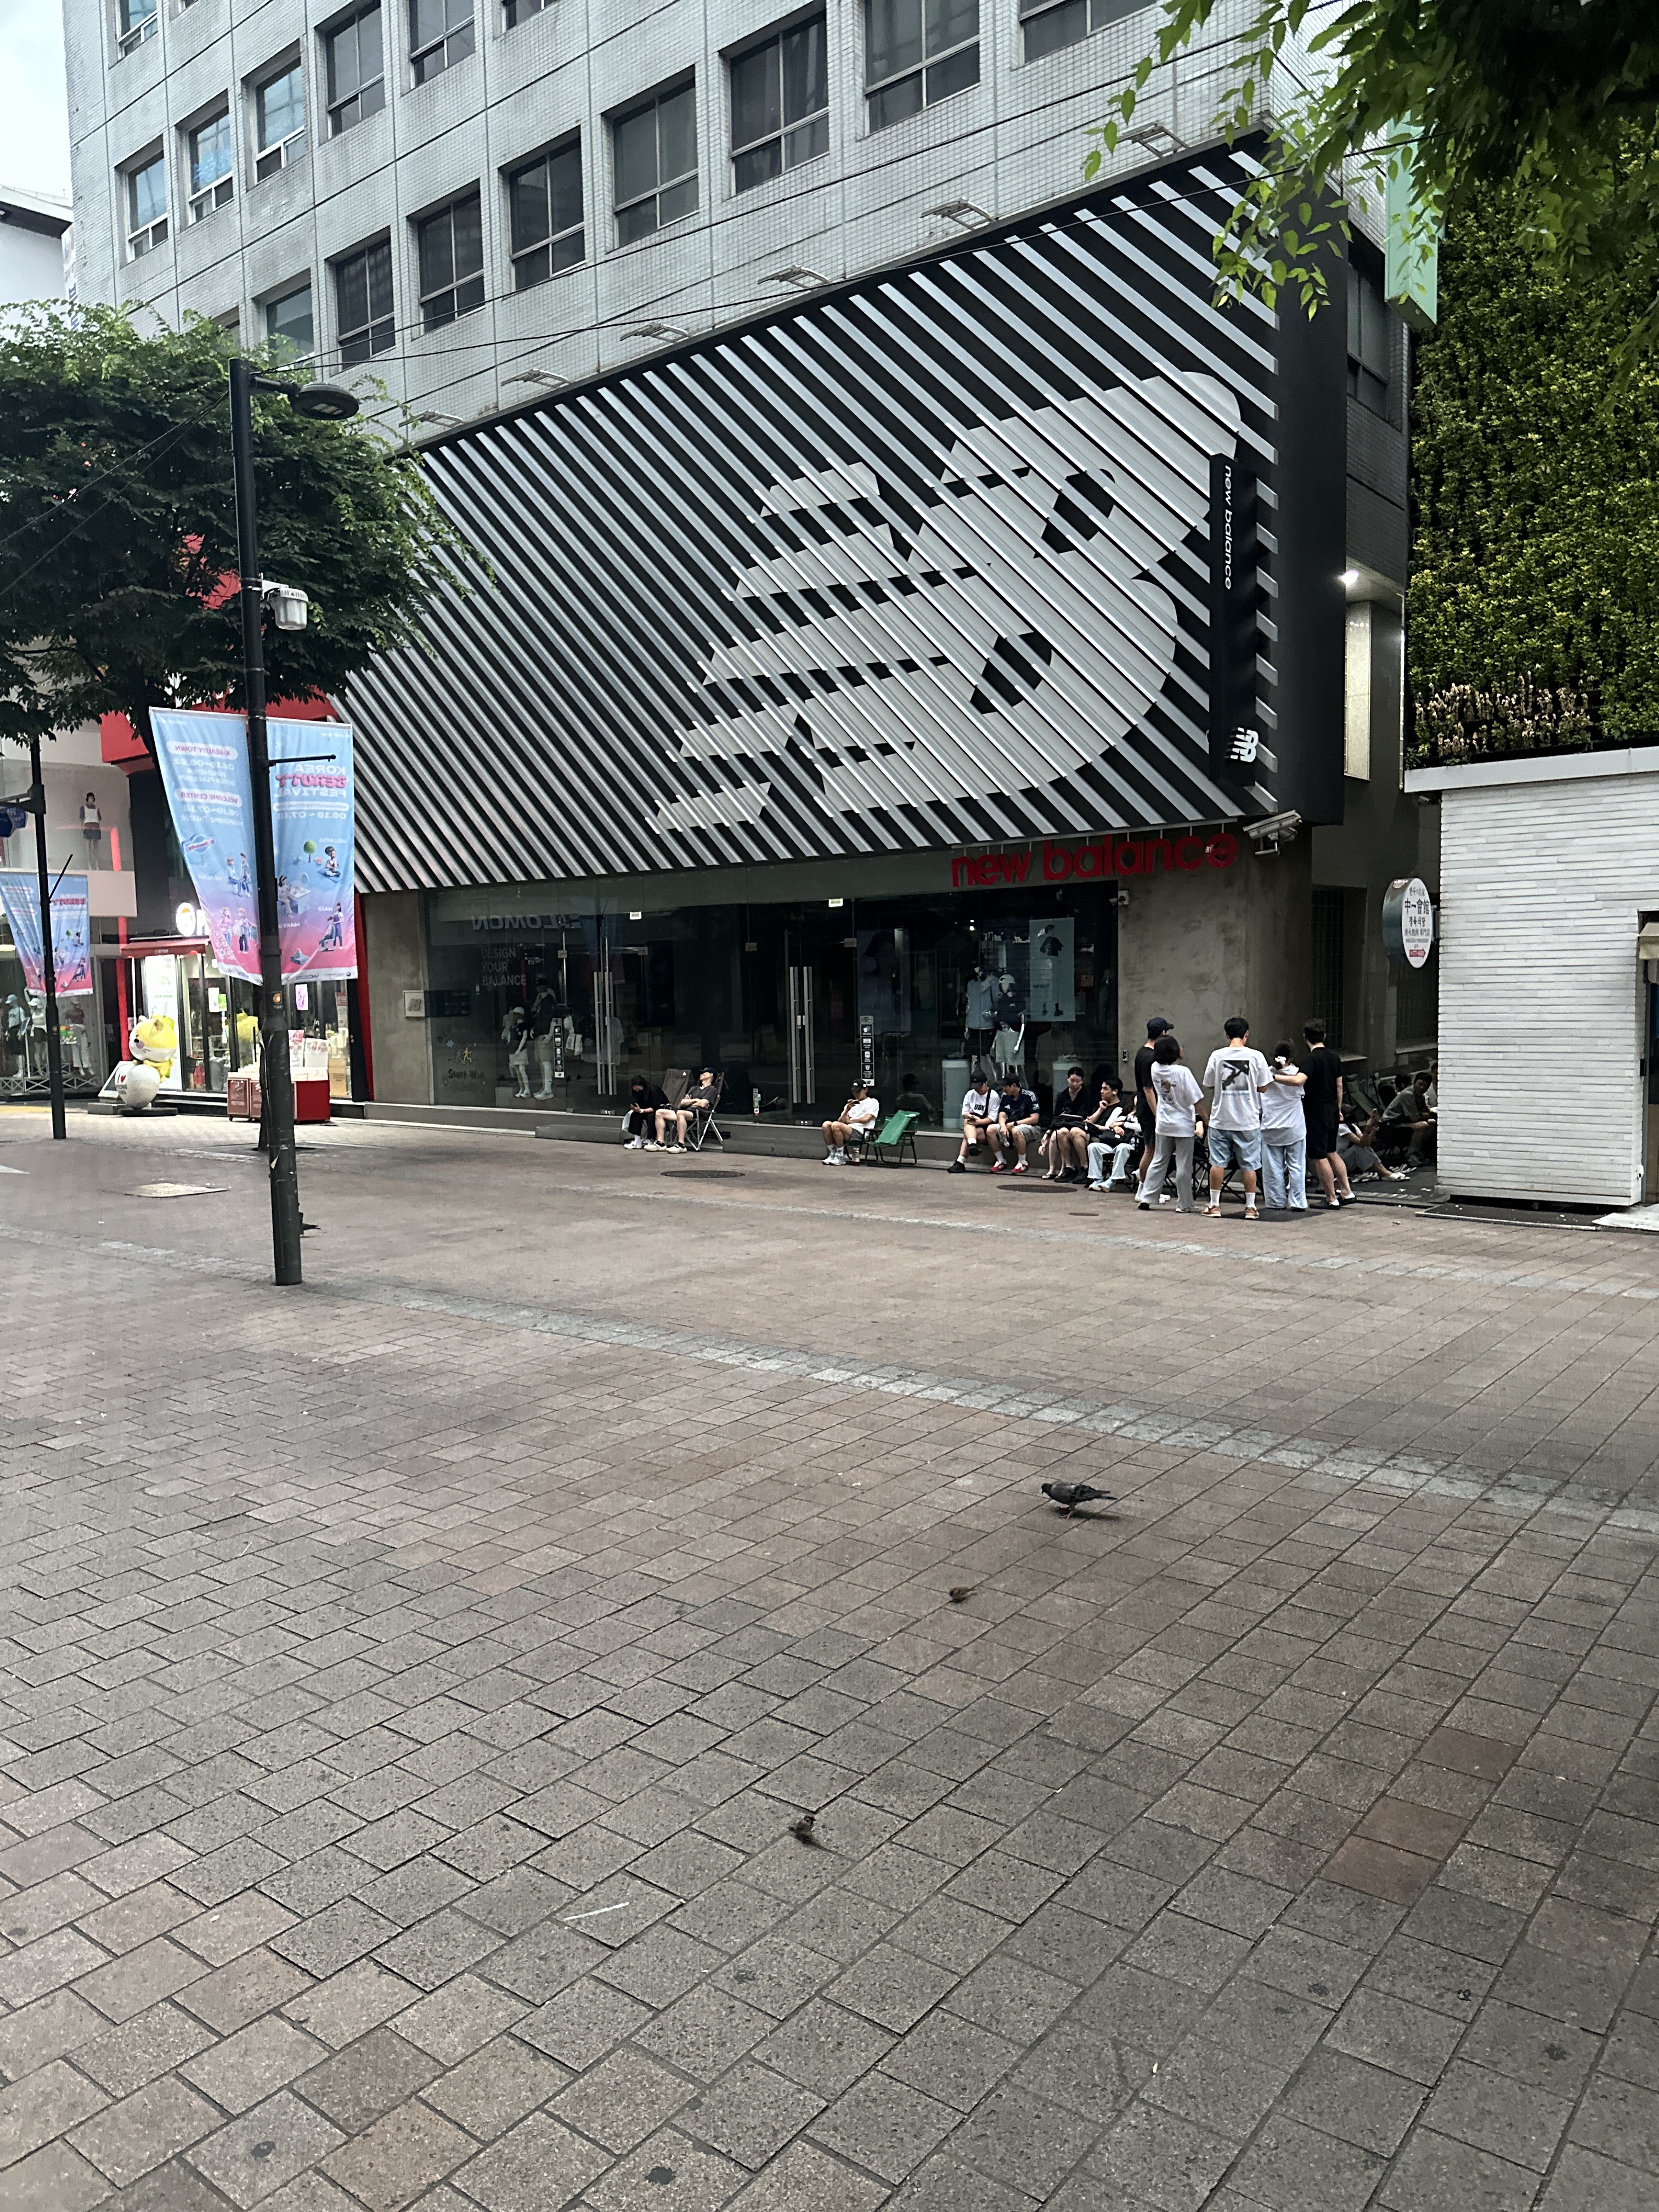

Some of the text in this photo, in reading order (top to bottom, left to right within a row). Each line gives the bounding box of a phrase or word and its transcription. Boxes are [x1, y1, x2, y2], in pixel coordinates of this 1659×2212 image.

[951, 833, 1238, 887] new balance
[481, 961, 509, 972] YOUR
[482, 974, 527, 986] BALANCE
